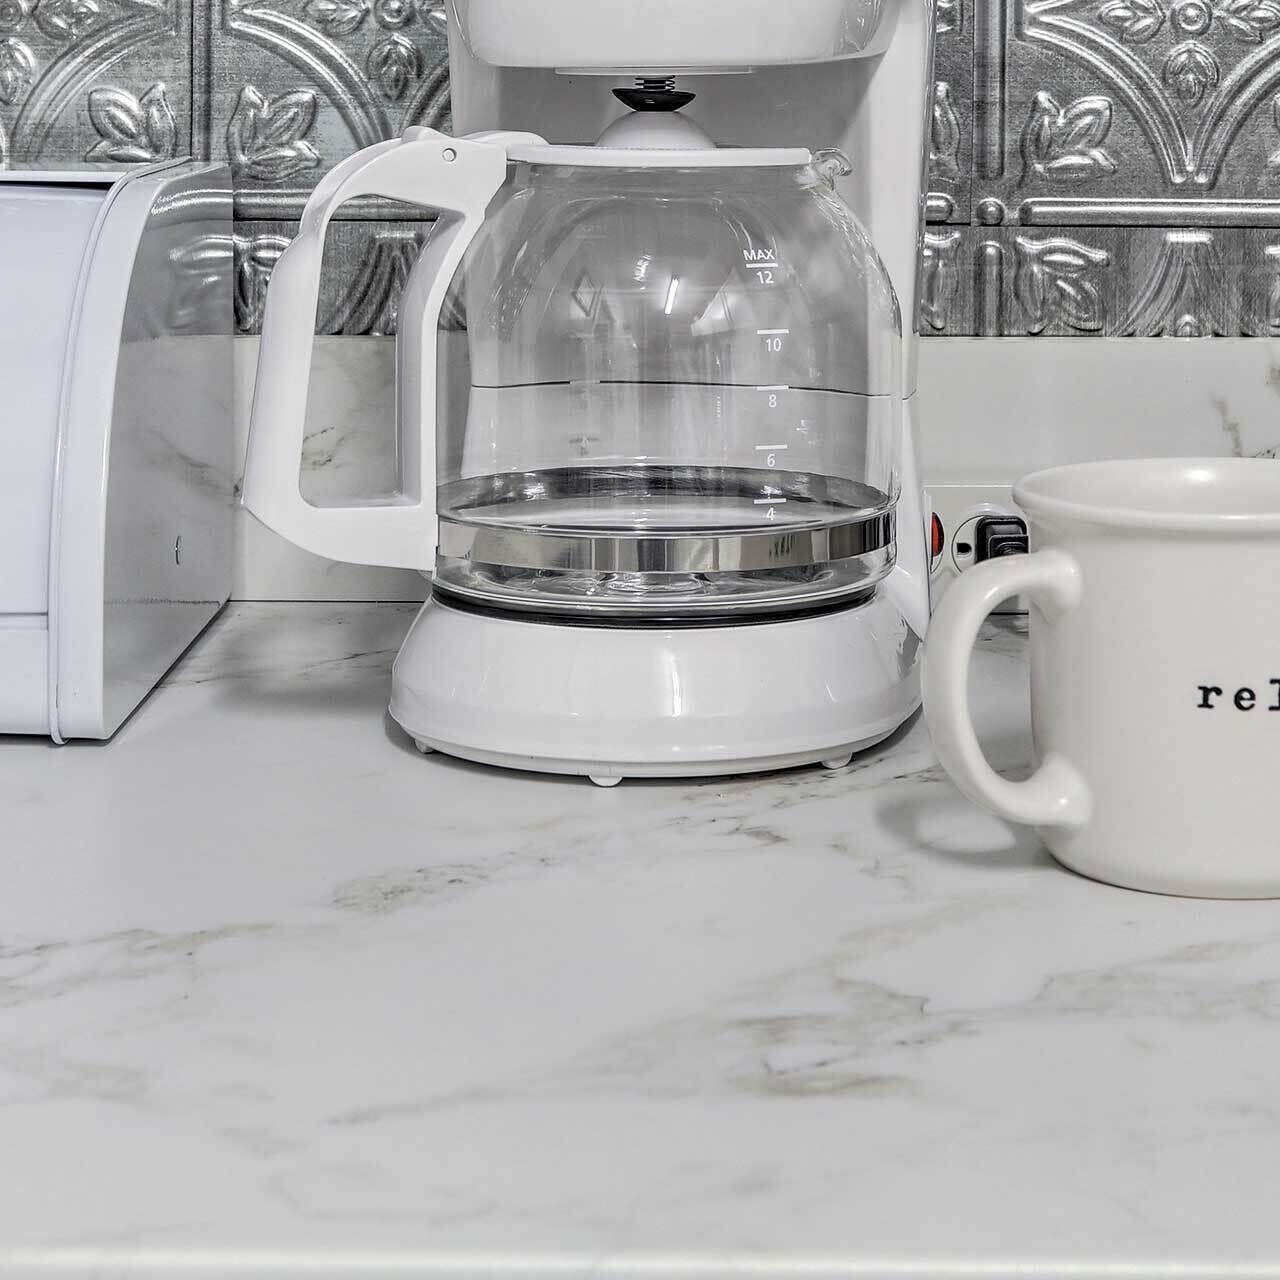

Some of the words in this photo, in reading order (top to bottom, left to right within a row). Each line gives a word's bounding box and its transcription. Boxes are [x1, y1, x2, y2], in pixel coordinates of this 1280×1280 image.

[743, 248, 775, 261] MAX
[756, 270, 775, 284] 12
[765, 337, 782, 352] 10
[768, 394, 777, 408] 8
[766, 453, 776, 467] 6
[766, 507, 776, 521] 4
